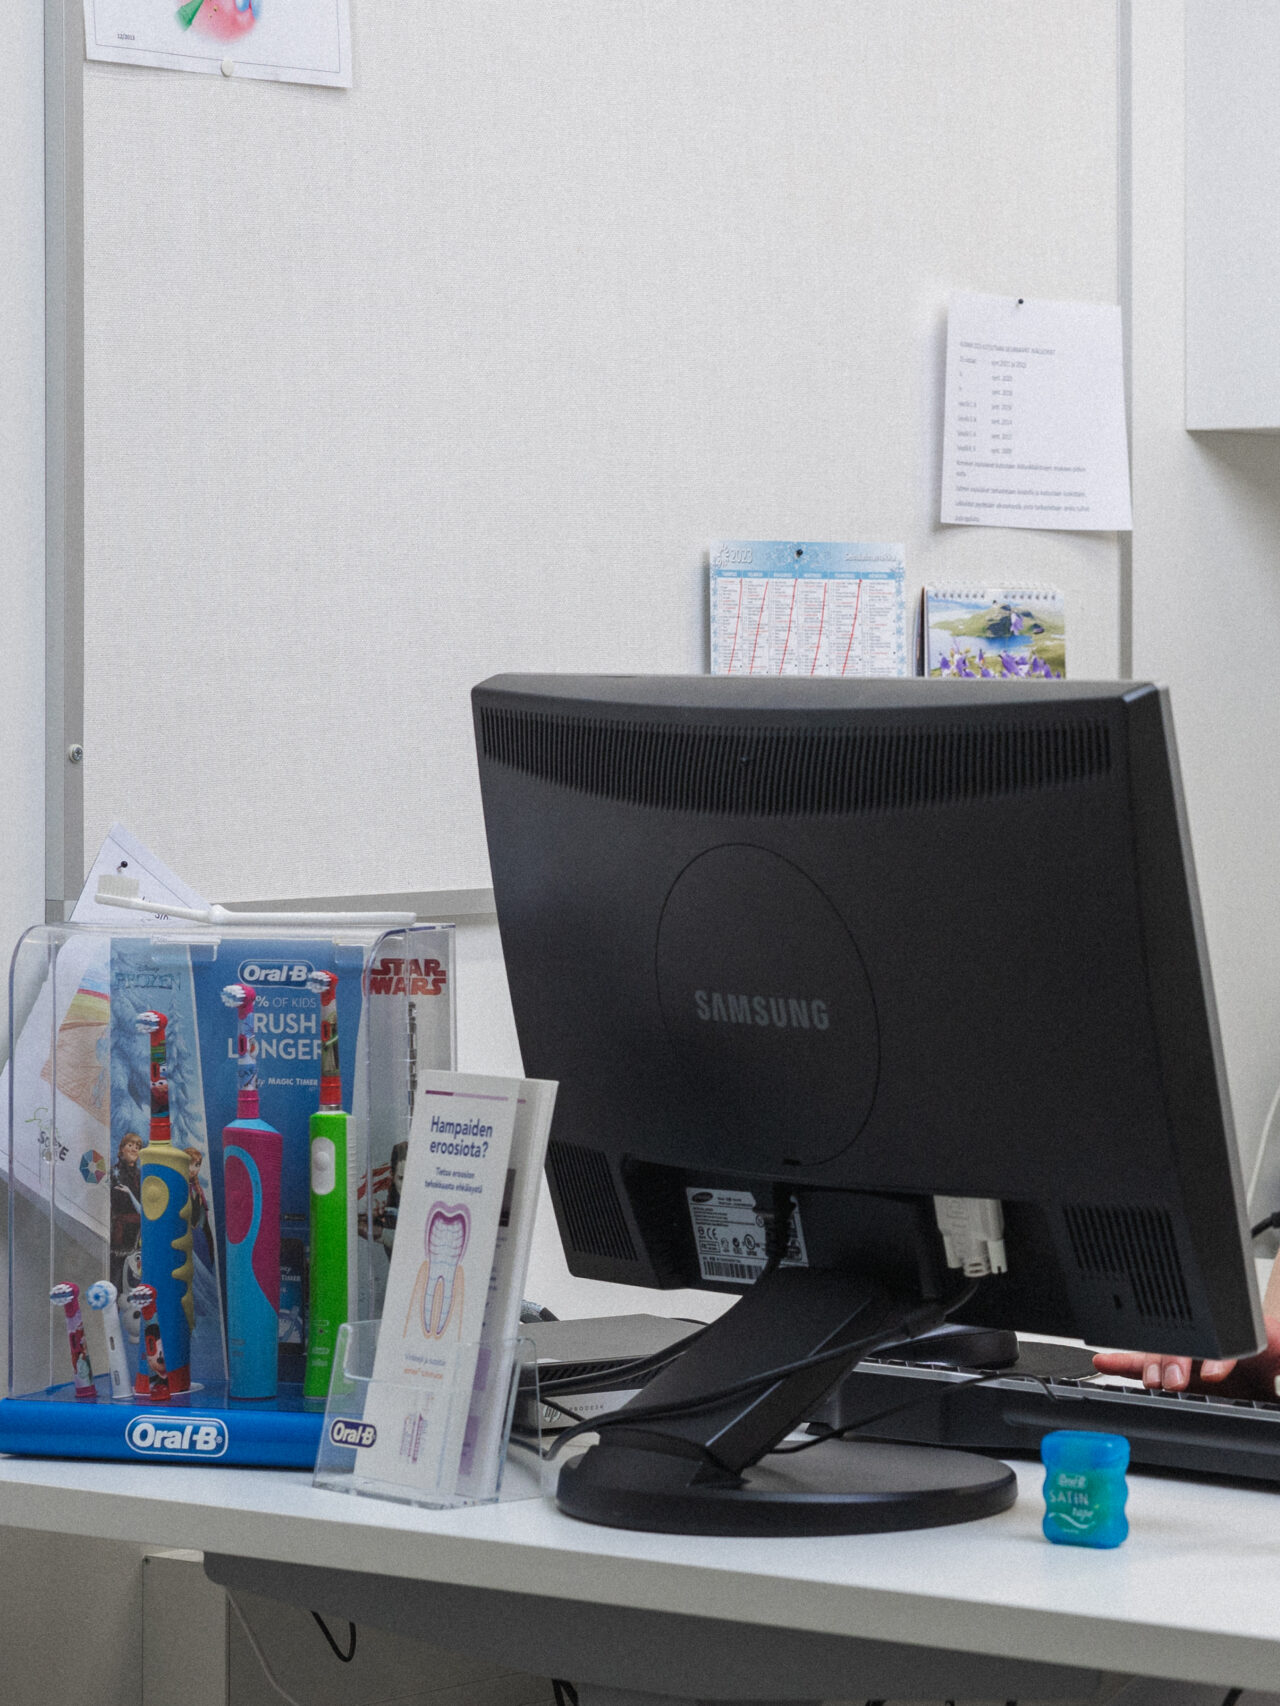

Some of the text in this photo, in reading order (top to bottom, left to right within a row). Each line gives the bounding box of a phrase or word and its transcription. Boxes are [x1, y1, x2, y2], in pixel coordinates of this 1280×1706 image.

[243, 965, 307, 982] Oral-B
[371, 958, 447, 977] STAR
[369, 976, 447, 995] WARS
[272, 998, 288, 1008] OF
[291, 998, 317, 1008] KIDS
[694, 990, 830, 1030] SAMSUNG
[253, 1013, 317, 1034] RUSH
[268, 1077, 294, 1086] MAGIC
[430, 1115, 493, 1139] Hampaiden
[429, 1140, 489, 1158] eroosiota?
[132, 1422, 218, 1450] Oral-B
[333, 1422, 375, 1446] Oral-B
[1049, 1489, 1089, 1505] SATIN
